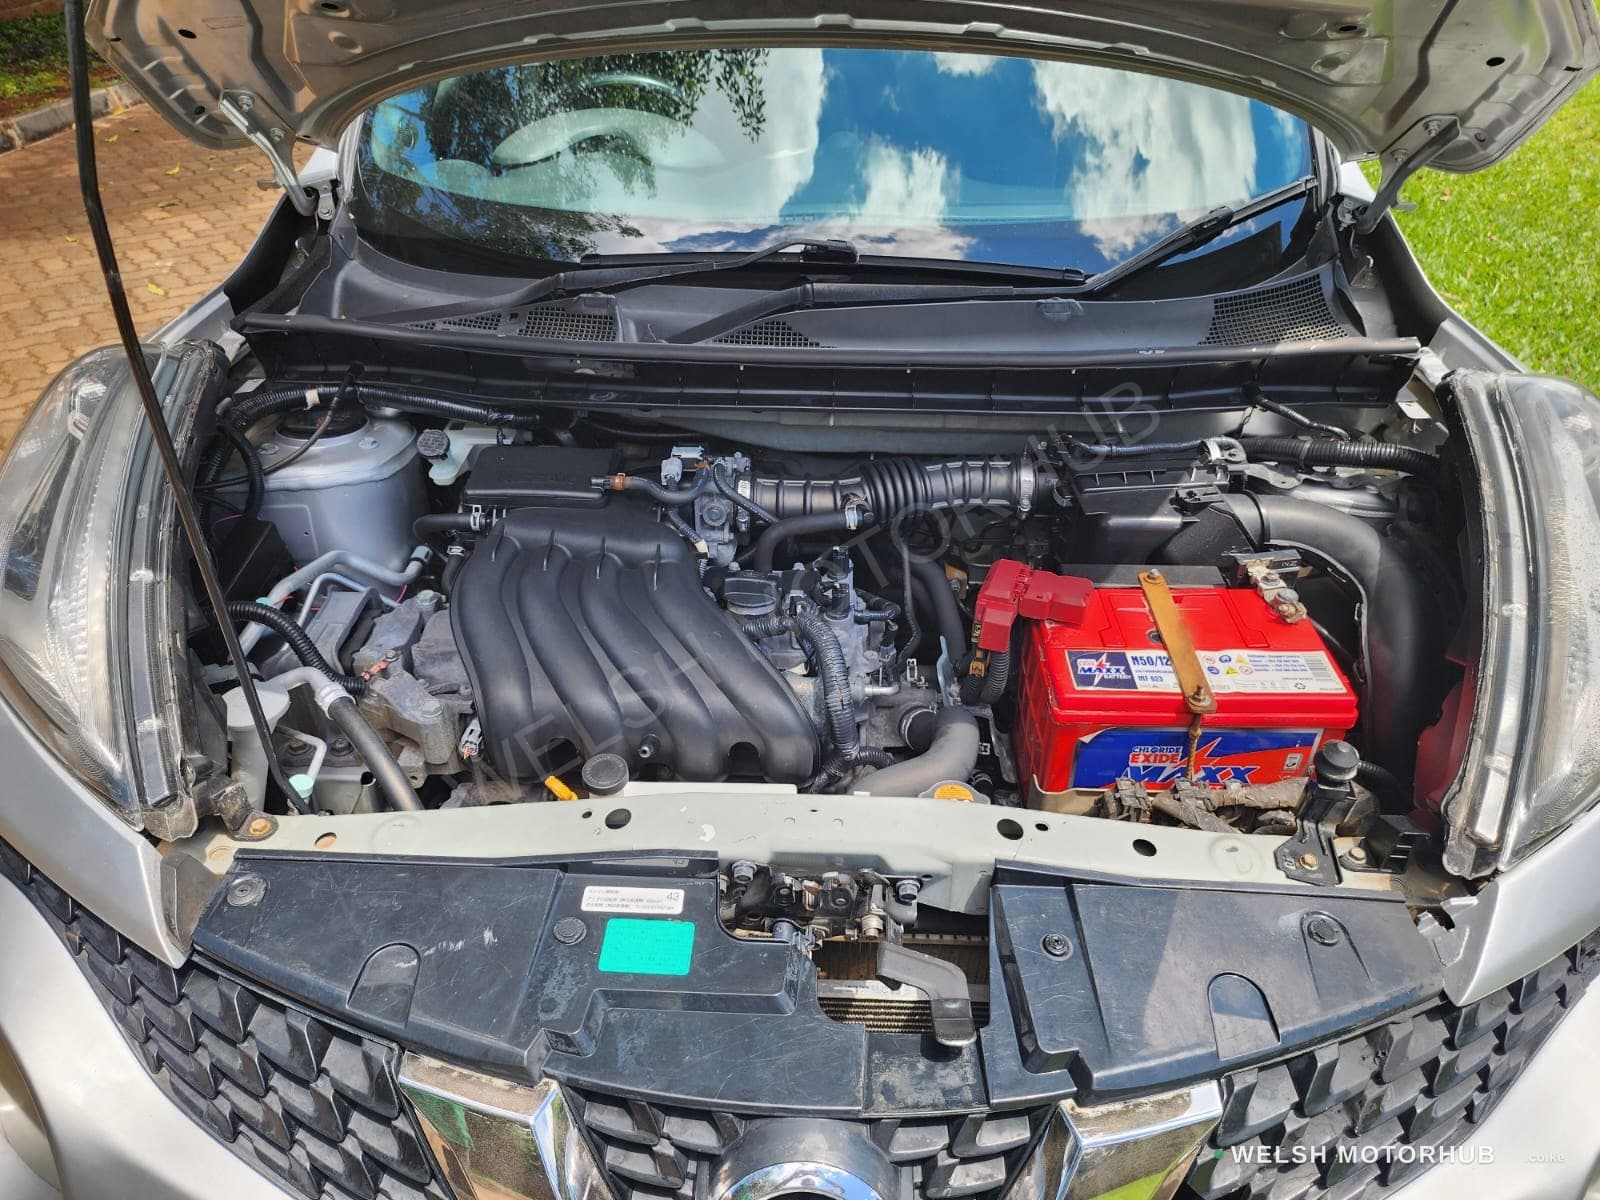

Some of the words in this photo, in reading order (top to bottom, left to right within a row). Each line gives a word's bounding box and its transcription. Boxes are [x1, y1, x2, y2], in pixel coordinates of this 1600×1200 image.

[1132, 745, 1183, 754] CHLORIDE
[1130, 752, 1181, 764] EXIDE
[1122, 764, 1259, 784] MAXX
[665, 891, 680, 901] 43
